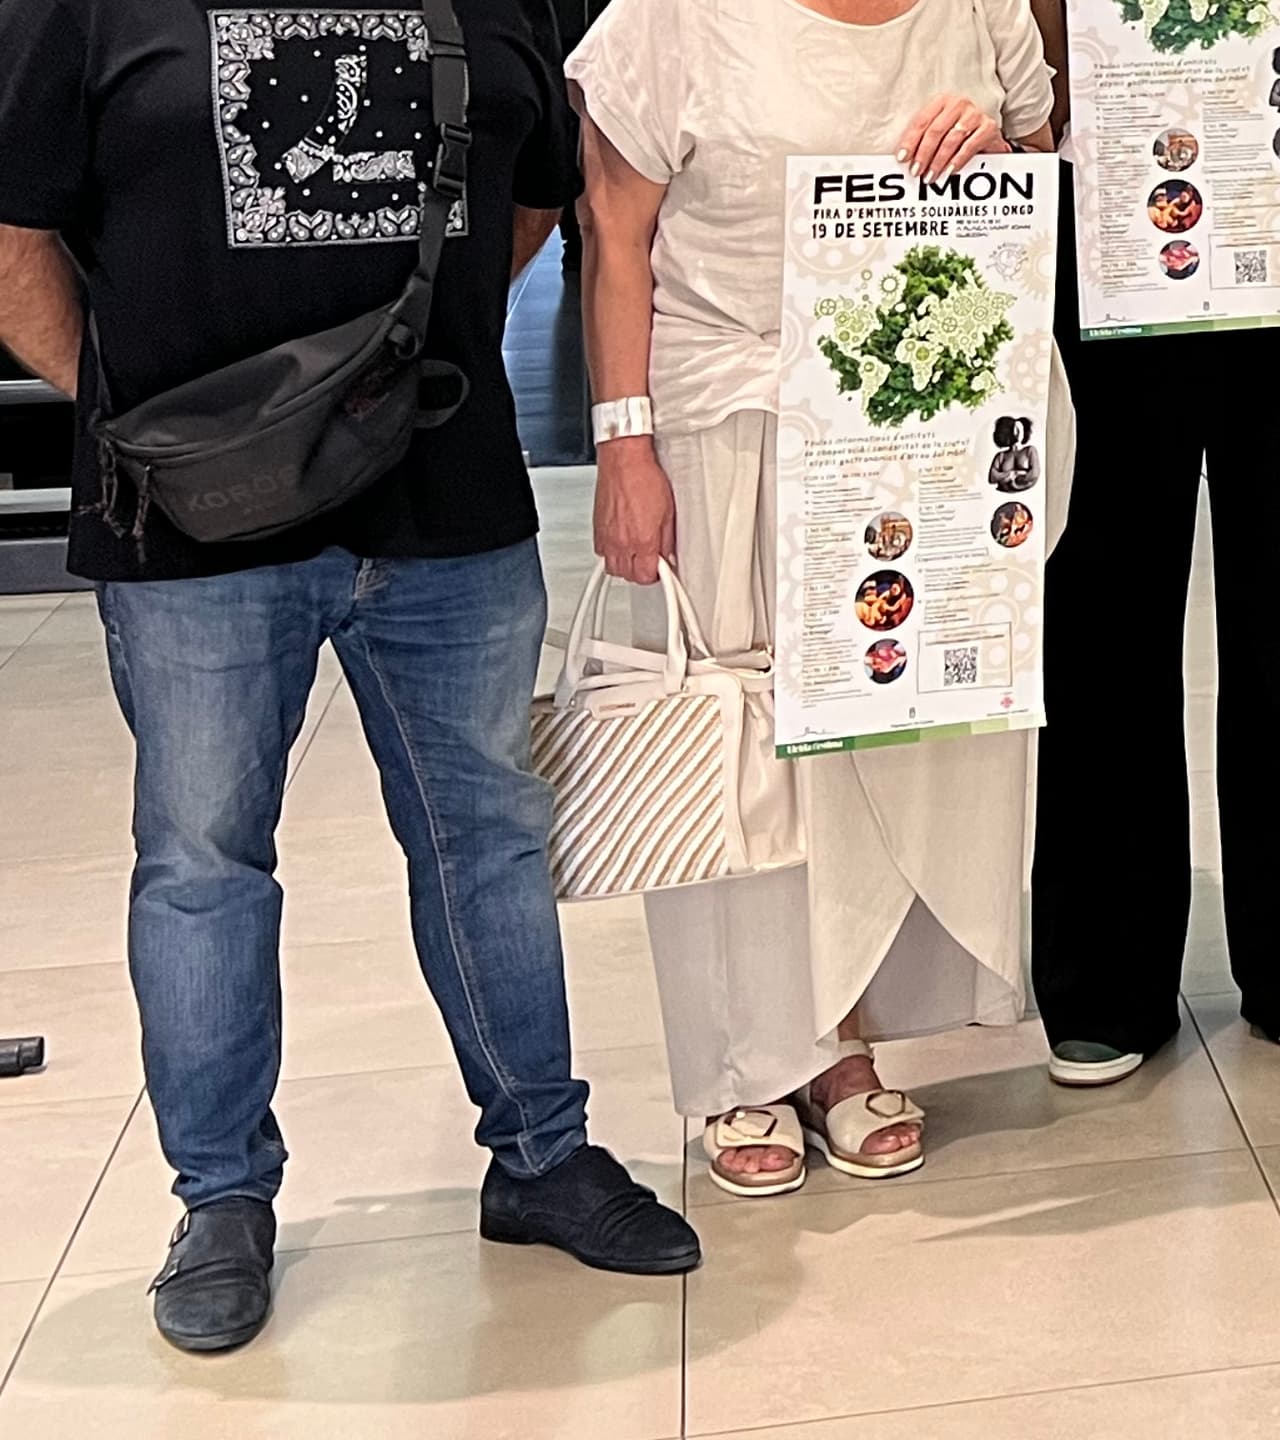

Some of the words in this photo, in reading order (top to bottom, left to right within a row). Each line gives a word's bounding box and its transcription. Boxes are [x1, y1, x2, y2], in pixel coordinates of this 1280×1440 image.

[813, 173, 906, 205] FES
[917, 161, 1034, 202] MÓN
[813, 208, 841, 220] FIRA
[845, 206, 916, 220] D'ENTITATS
[1001, 204, 1034, 217] ONGD
[811, 223, 827, 240] 19
[834, 222, 856, 239] DE
[862, 220, 949, 239] SETEMBRE
